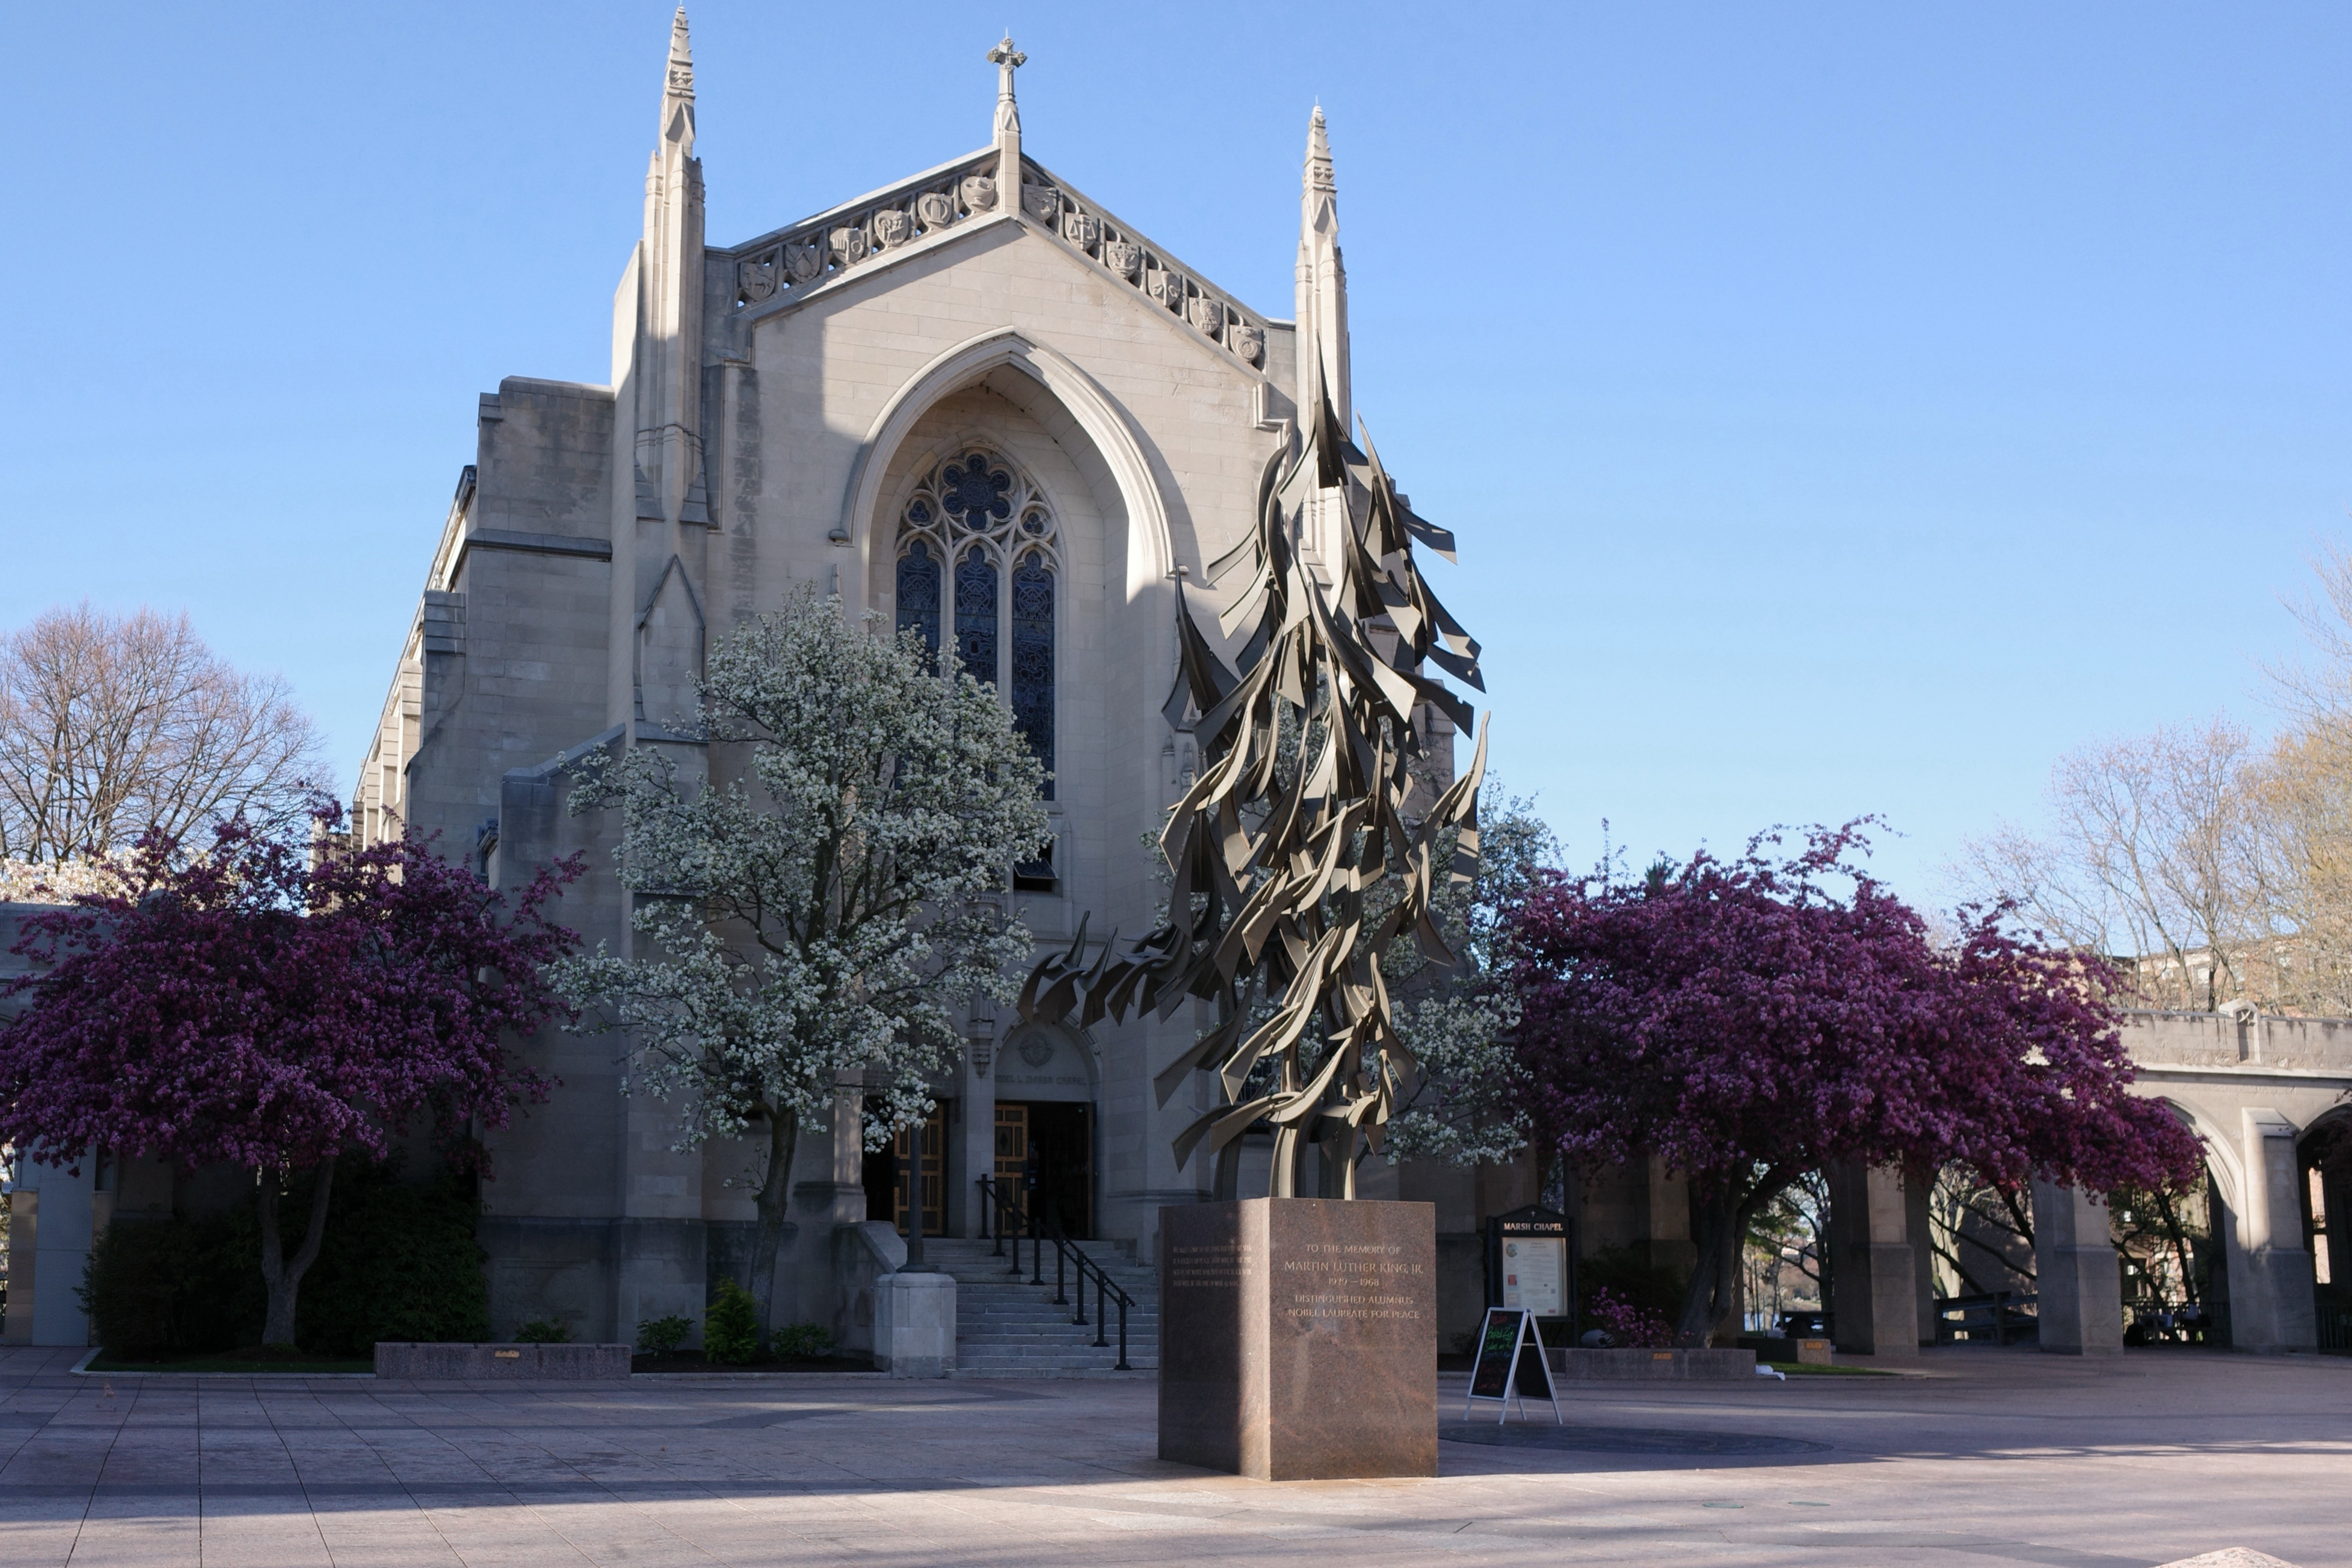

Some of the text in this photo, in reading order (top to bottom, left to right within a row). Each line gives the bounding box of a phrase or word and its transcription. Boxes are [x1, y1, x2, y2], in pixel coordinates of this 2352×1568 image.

[1504, 1222, 1564, 1231] MARSH CHAPEL
[1306, 1244, 1401, 1254] TO THE MEMORY OF
[1285, 1261, 1424, 1274] MARTIN LUTHER KING, JR.
[1328, 1278, 1348, 1286] 1929
[1360, 1278, 1380, 1286] 1968
[1295, 1294, 1414, 1305] DISTINGUISHED ALUMNUS
[1288, 1308, 1421, 1319] NOBEL LAUREATE FOR PEACE
